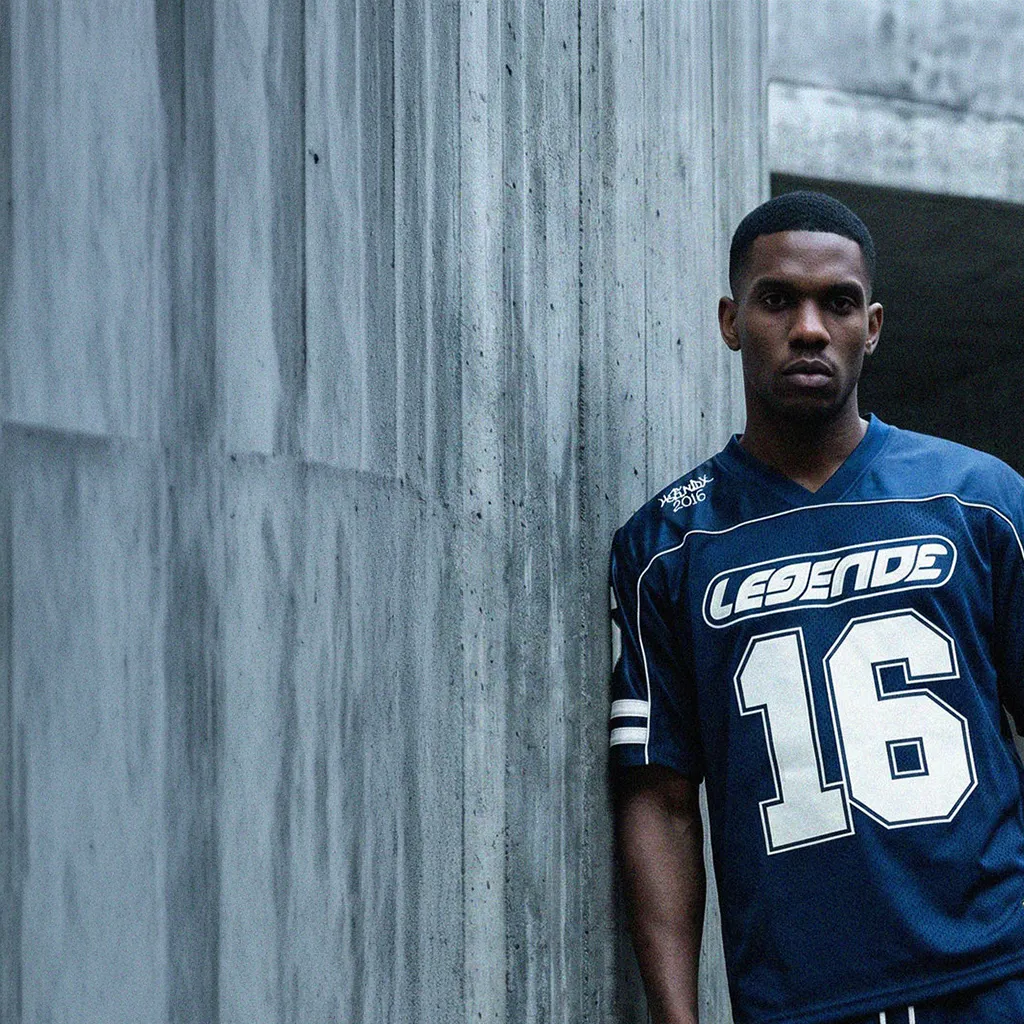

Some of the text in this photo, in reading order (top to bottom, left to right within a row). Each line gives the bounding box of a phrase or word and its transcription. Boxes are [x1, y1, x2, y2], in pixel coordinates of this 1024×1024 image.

[673, 489, 706, 513] 2016
[709, 543, 948, 620] LEGENDE
[733, 608, 979, 855] 16
